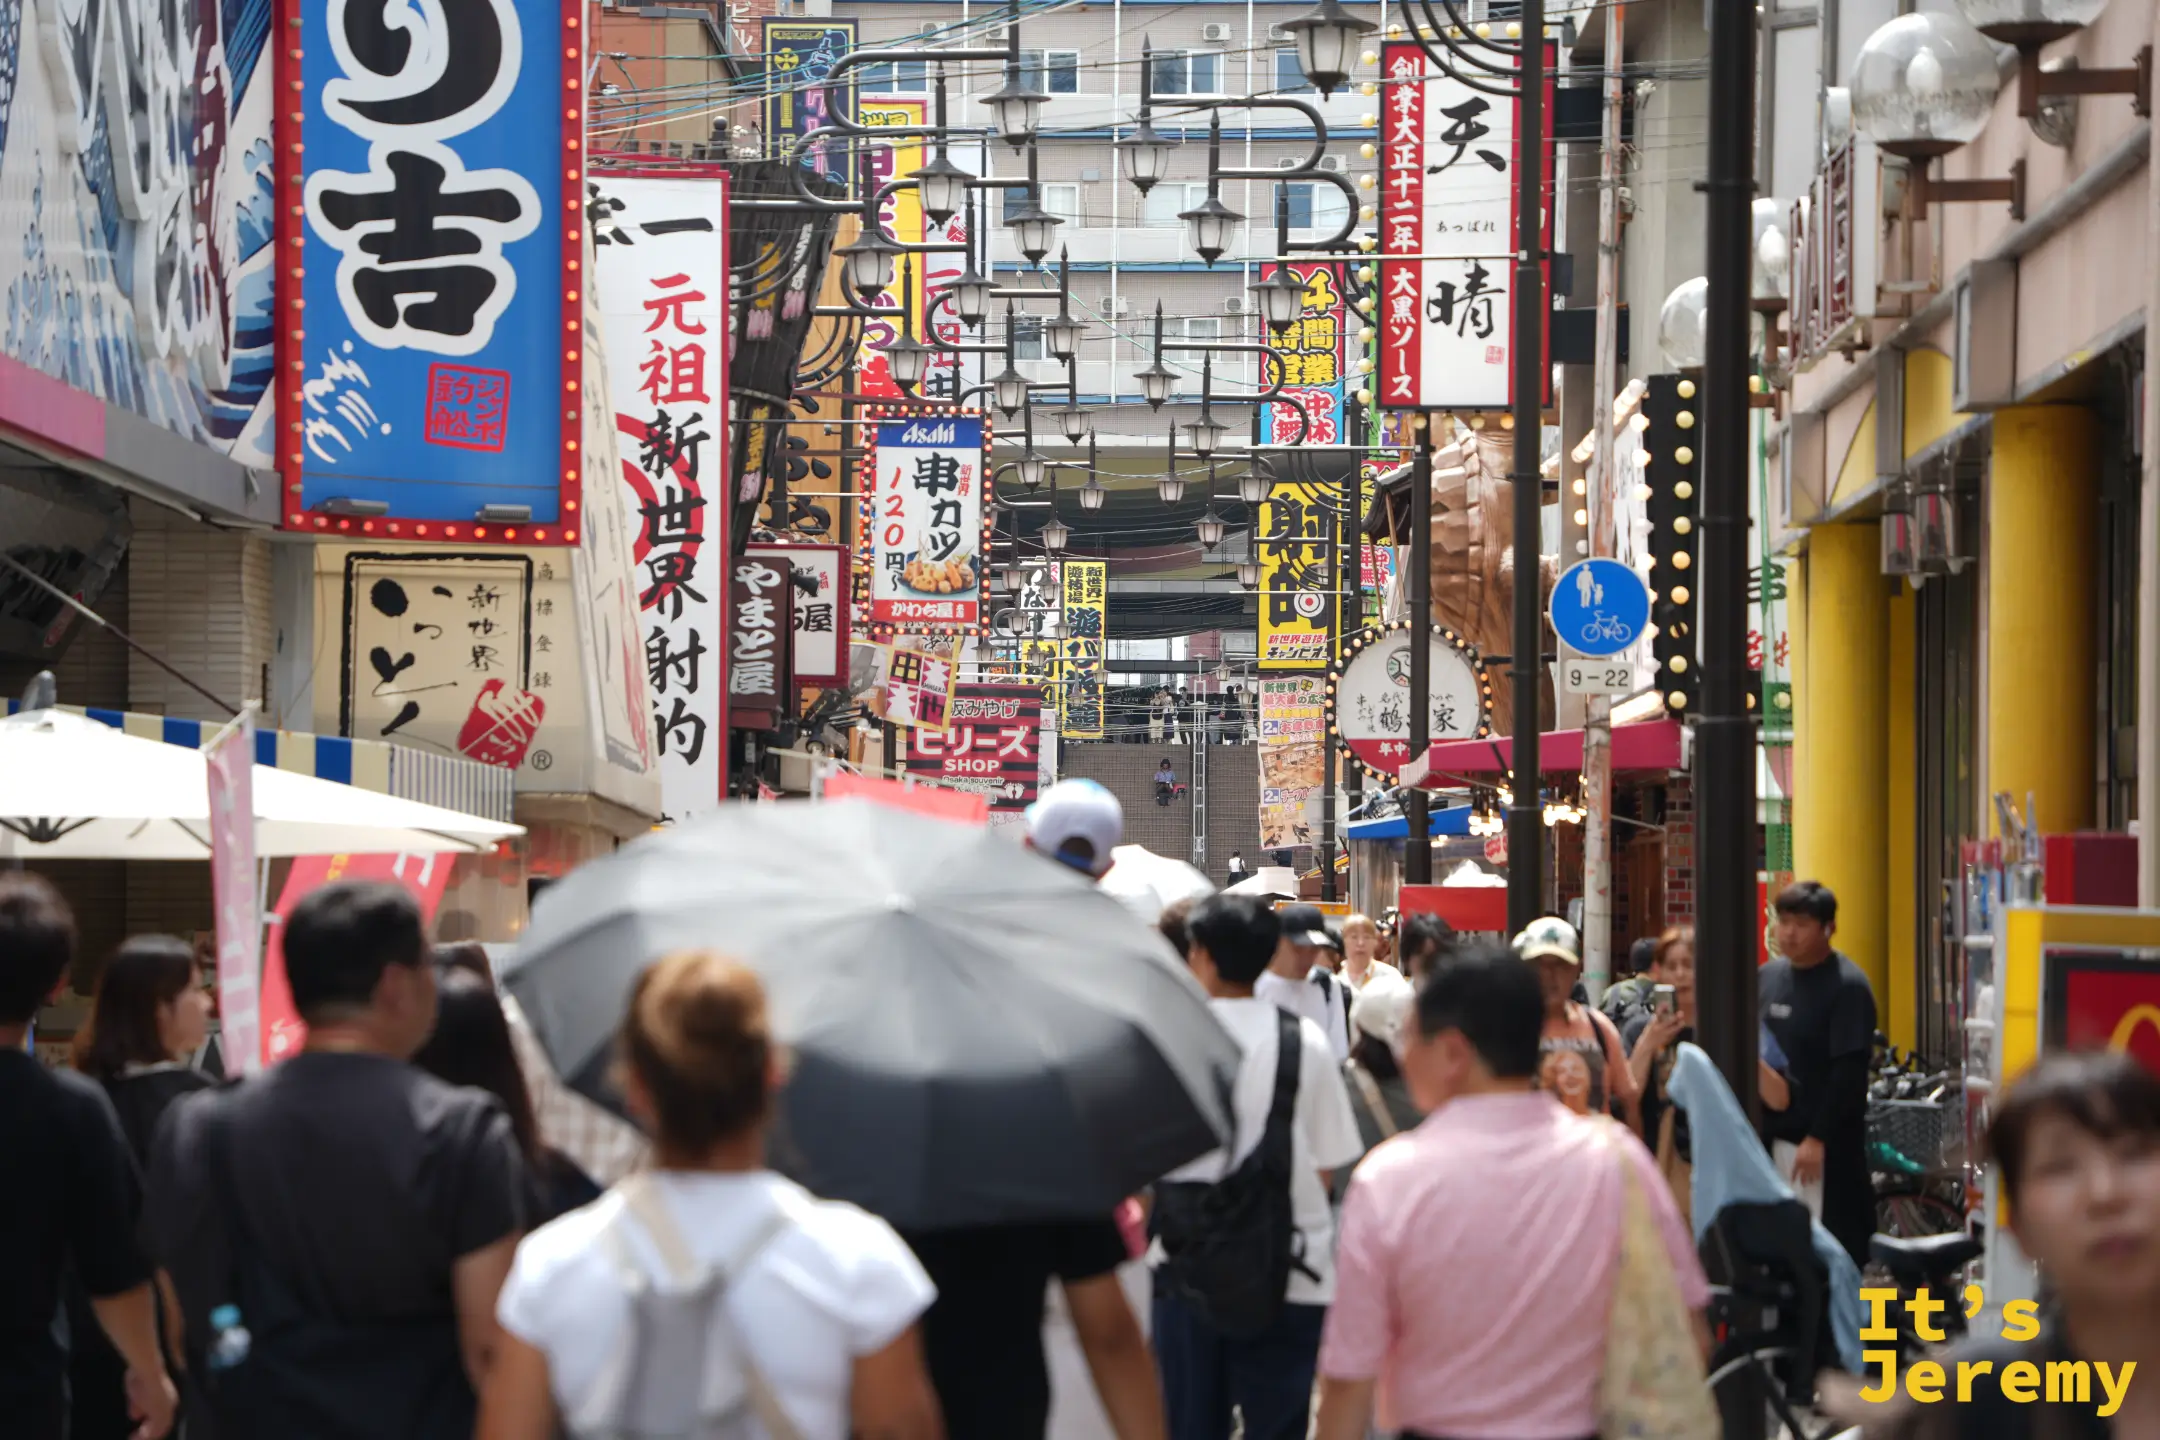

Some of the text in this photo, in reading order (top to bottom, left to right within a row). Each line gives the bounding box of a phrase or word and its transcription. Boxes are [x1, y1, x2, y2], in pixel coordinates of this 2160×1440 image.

[1389, 56, 1421, 399] 創業大正十二年 大黒ソース
[1427, 96, 1507, 339] 天 晴
[430, 373, 476, 440] 釣船
[473, 377, 502, 443] ジャンボ
[901, 423, 956, 444] Asahi
[912, 451, 962, 562] 串カツ
[466, 583, 509, 672] 新世界
[730, 561, 781, 695] やまと屋
[891, 601, 954, 618] かわち屋
[1268, 634, 1328, 644] 新世界遊技
[1380, 702, 1459, 734] 鶴家
[944, 759, 1000, 773] SHOP
[970, 776, 1004, 785] souvenir
